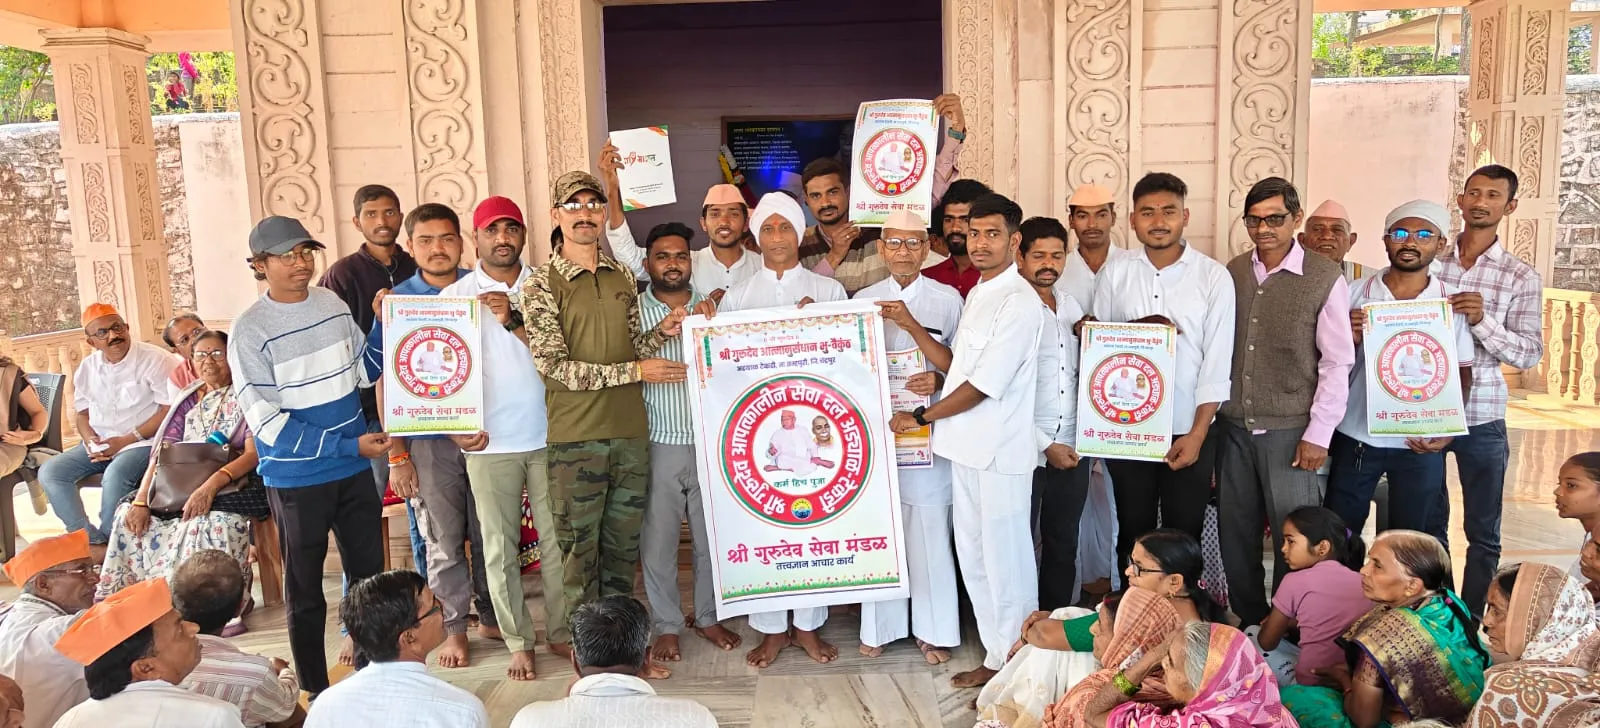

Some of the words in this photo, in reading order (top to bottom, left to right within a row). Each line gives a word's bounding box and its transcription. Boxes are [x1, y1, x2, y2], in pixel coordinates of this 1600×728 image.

[432, 328, 449, 340] सेवा
[449, 337, 461, 349] दल
[720, 348, 730, 360] श्री
[732, 346, 758, 362] गुरुदेव
[760, 342, 818, 357] आत्मानुसंधान
[1128, 355, 1143, 368] सेवा
[790, 381, 824, 404] सेवा
[392, 406, 403, 416] श्री
[406, 406, 433, 418] गुरुदेव
[822, 393, 848, 420] दल
[1376, 411, 1387, 419] श्री
[732, 387, 788, 456] आपत्कालीन
[1084, 428, 1094, 438] श्री
[1097, 430, 1122, 441] गुरुदेव
[1125, 431, 1140, 440] सेवा
[733, 460, 770, 504] गुरुदेव
[774, 479, 789, 488] कर्म
[792, 478, 807, 487] हिच
[810, 478, 826, 488] पुजा
[763, 495, 786, 515] श्री
[727, 543, 748, 564] श्री
[754, 540, 802, 564] गुरुदेव
[809, 536, 840, 557] सेवा
[846, 533, 888, 552] मंडळ
[836, 555, 855, 564] कार्य
